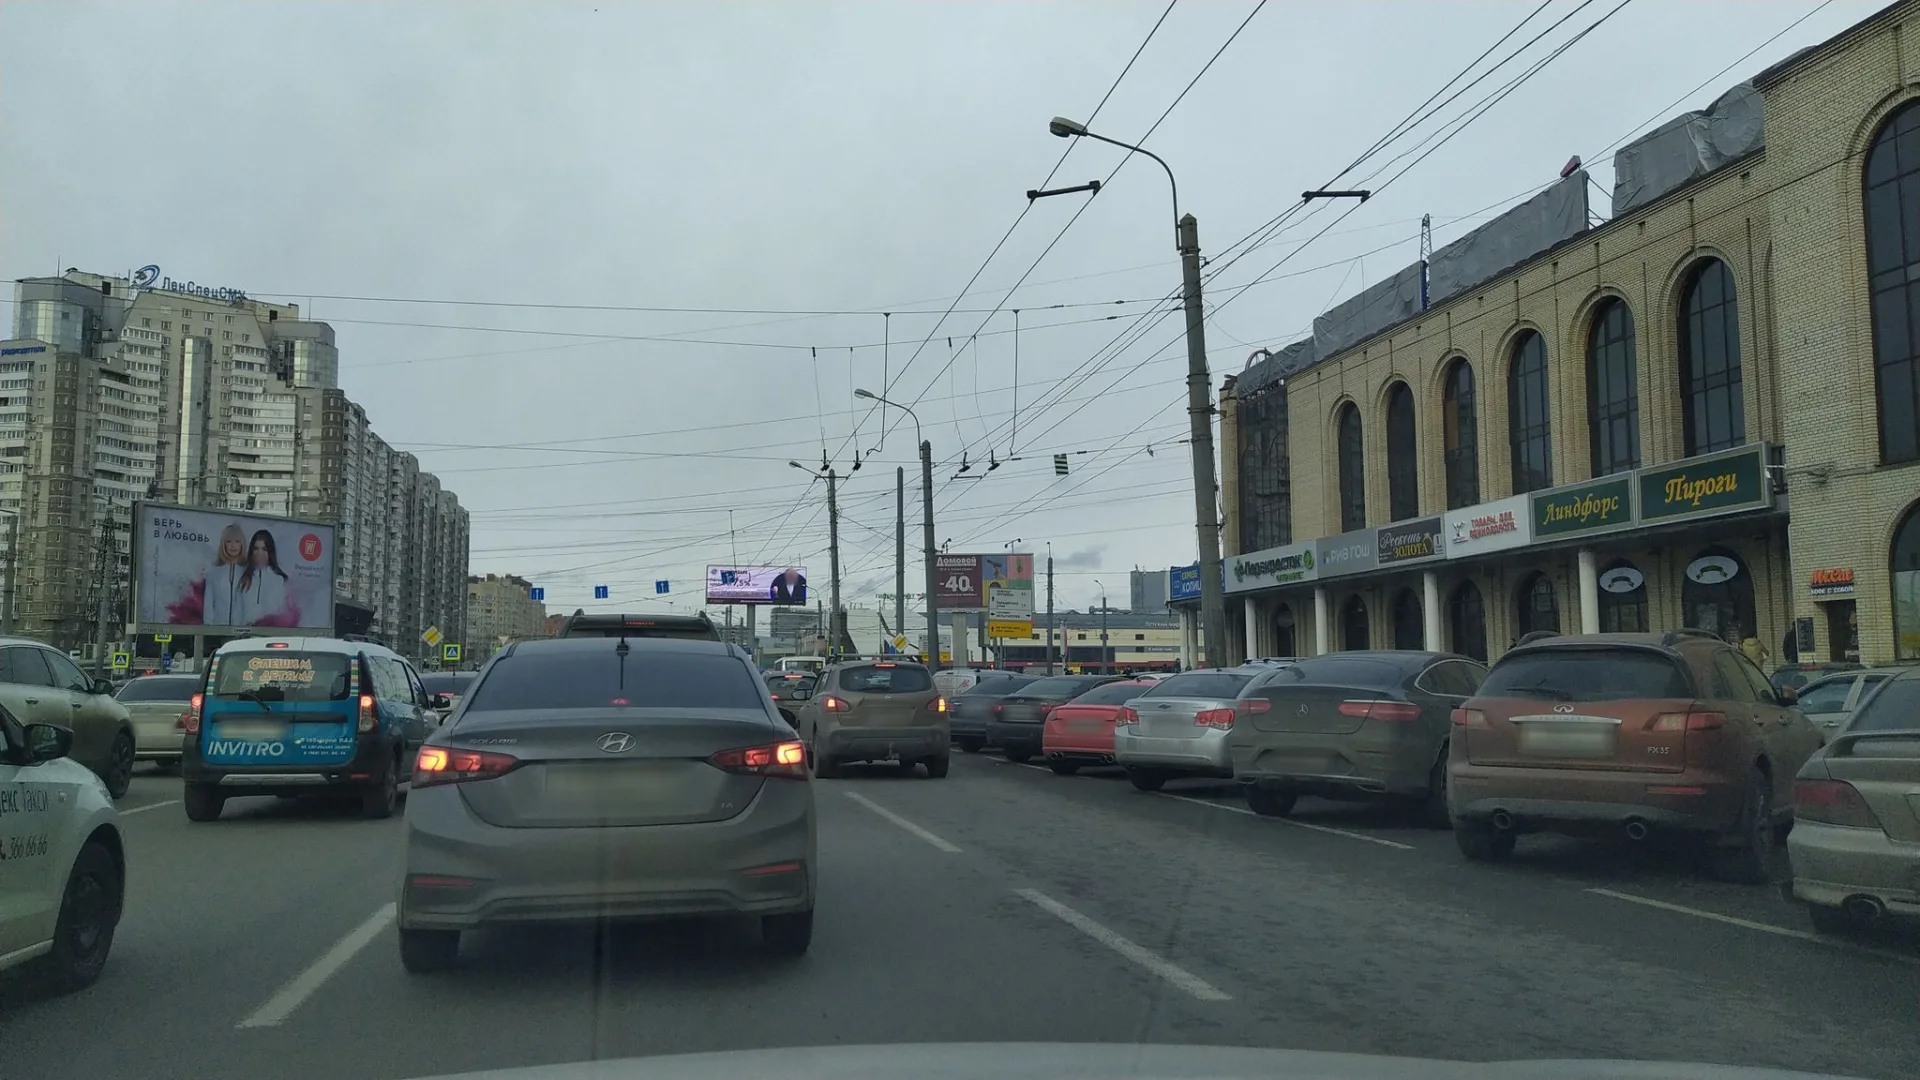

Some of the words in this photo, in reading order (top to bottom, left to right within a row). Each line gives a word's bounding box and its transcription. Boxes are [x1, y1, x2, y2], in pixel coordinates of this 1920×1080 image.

[1664, 473, 1737, 506] Пироги
[1543, 493, 1619, 526] Линдфорс
[153, 517, 182, 528] ВЕРЬ
[154, 529, 160, 538] В
[164, 530, 210, 543] ЛЮБОВЬ
[1393, 541, 1429, 558] ЗОЛОТА
[936, 556, 977, 567] Домовой
[248, 657, 312, 670] СПЕШИМ
[242, 670, 253, 681] К
[260, 670, 315, 681] ДЕТЯМ!
[207, 740, 284, 756] INVITRO
